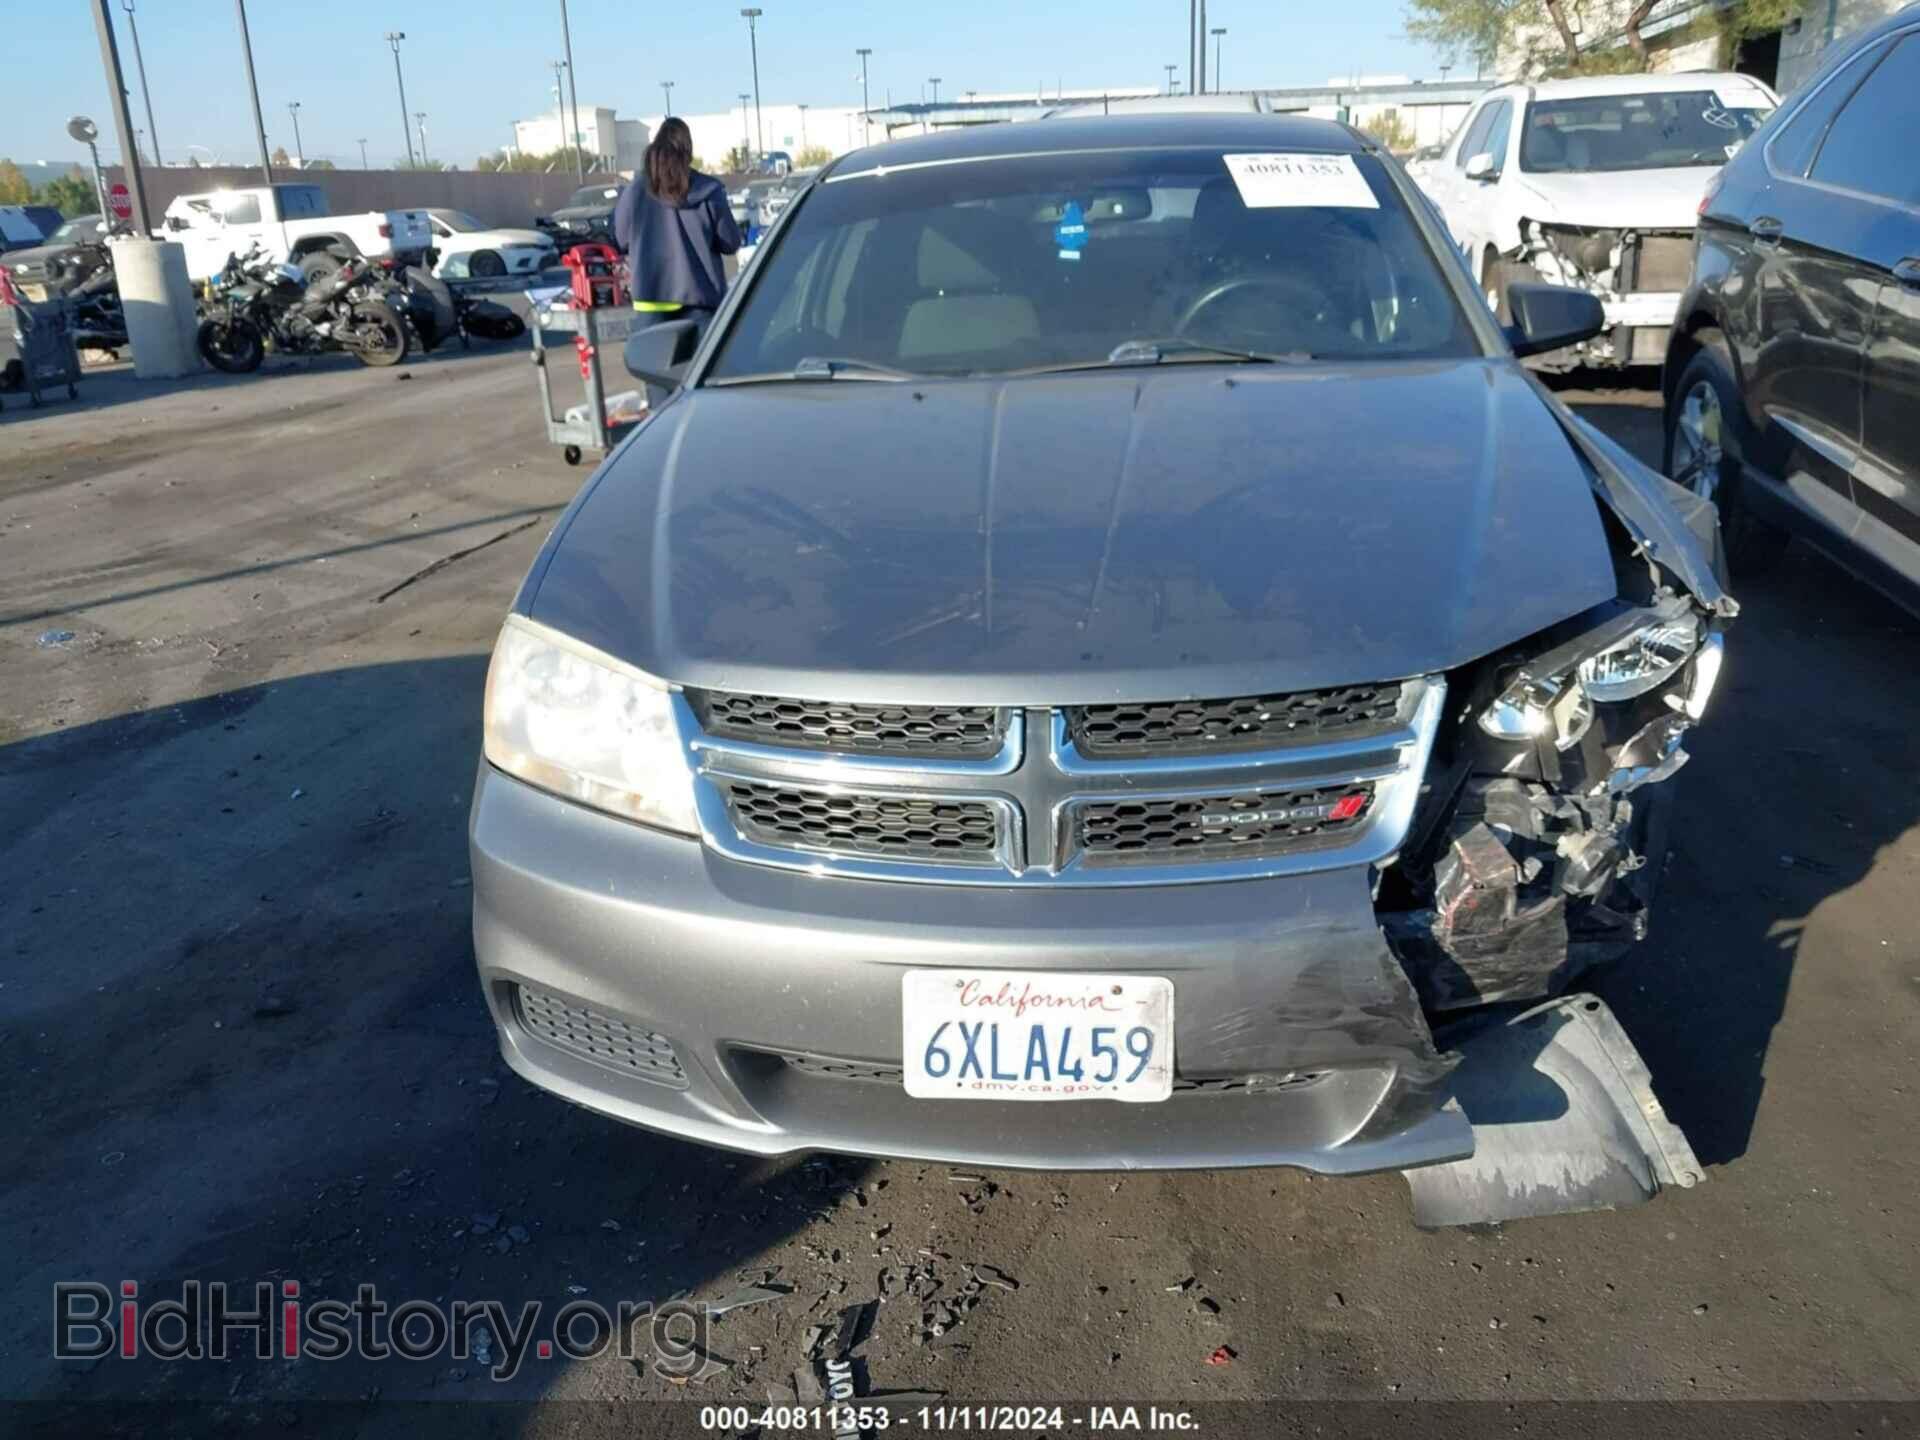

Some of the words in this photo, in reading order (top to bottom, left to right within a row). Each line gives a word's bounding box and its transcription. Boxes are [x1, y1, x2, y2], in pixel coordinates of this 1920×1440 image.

[959, 979, 1122, 1017] California
[924, 1021, 1154, 1084] 6XLA459
[971, 1080, 1104, 1093] dmv.ca.gov
